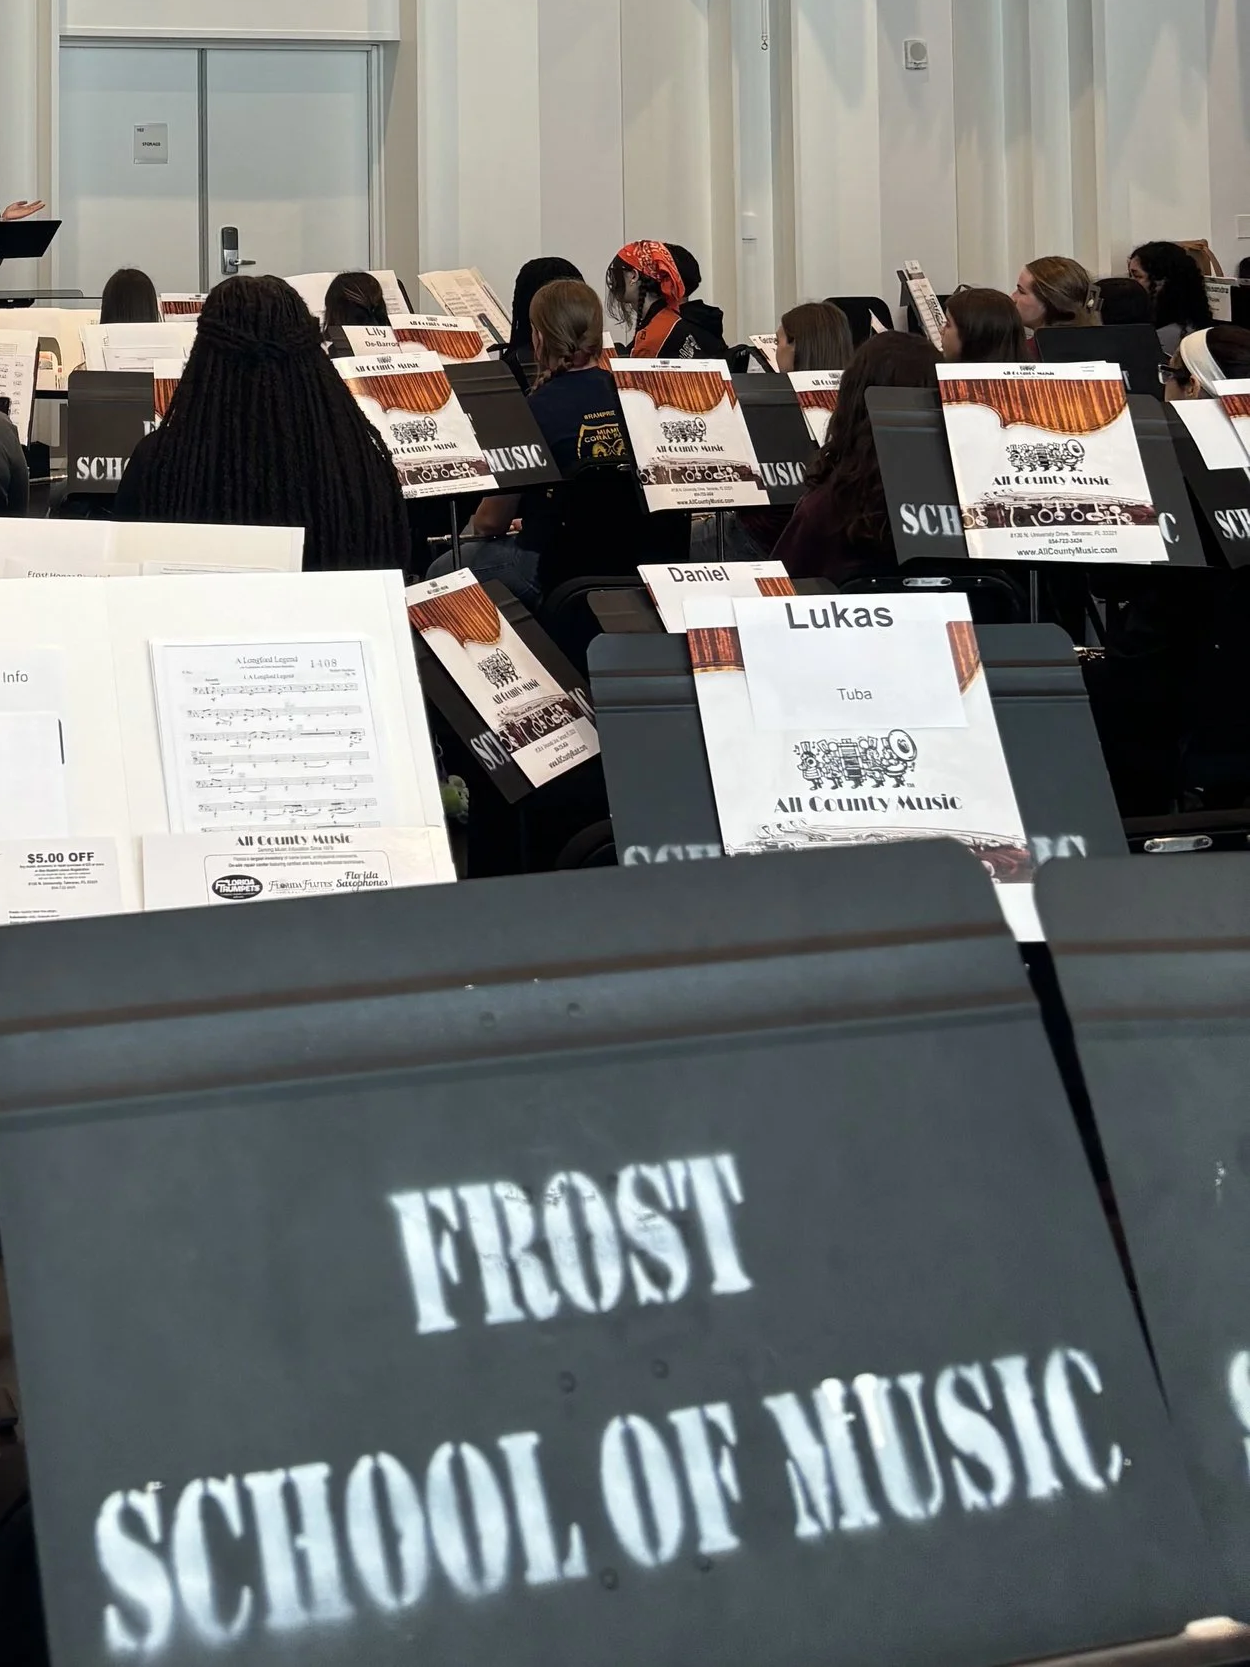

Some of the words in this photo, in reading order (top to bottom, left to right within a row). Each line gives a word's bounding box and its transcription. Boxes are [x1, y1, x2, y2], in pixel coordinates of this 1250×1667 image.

[365, 327, 387, 338] Lily
[481, 444, 547, 474] MUSIC
[991, 476, 1011, 486] All
[1014, 475, 1068, 487] County
[1070, 475, 1113, 486] Music
[1016, 547, 1118, 557] www.AllCountyMusic.com
[666, 565, 731, 583] Daniel
[784, 601, 895, 630] Lukas
[2, 670, 29, 683] Info
[837, 687, 873, 701] Tuba
[774, 797, 801, 814] All
[808, 795, 889, 815] County
[896, 794, 963, 811] Music
[235, 836, 254, 847] All
[257, 834, 309, 846] County
[310, 833, 354, 845] Music
[27, 852, 65, 864] $5.00
[67, 851, 95, 862] OFF
[344, 870, 379, 881] Florida
[335, 878, 388, 890] Saxophones
[386, 1149, 754, 1335] FROST
[94, 1430, 590, 1656] SCHOOL
[599, 1401, 743, 1568] OF
[763, 1344, 1125, 1539] MUSIC
